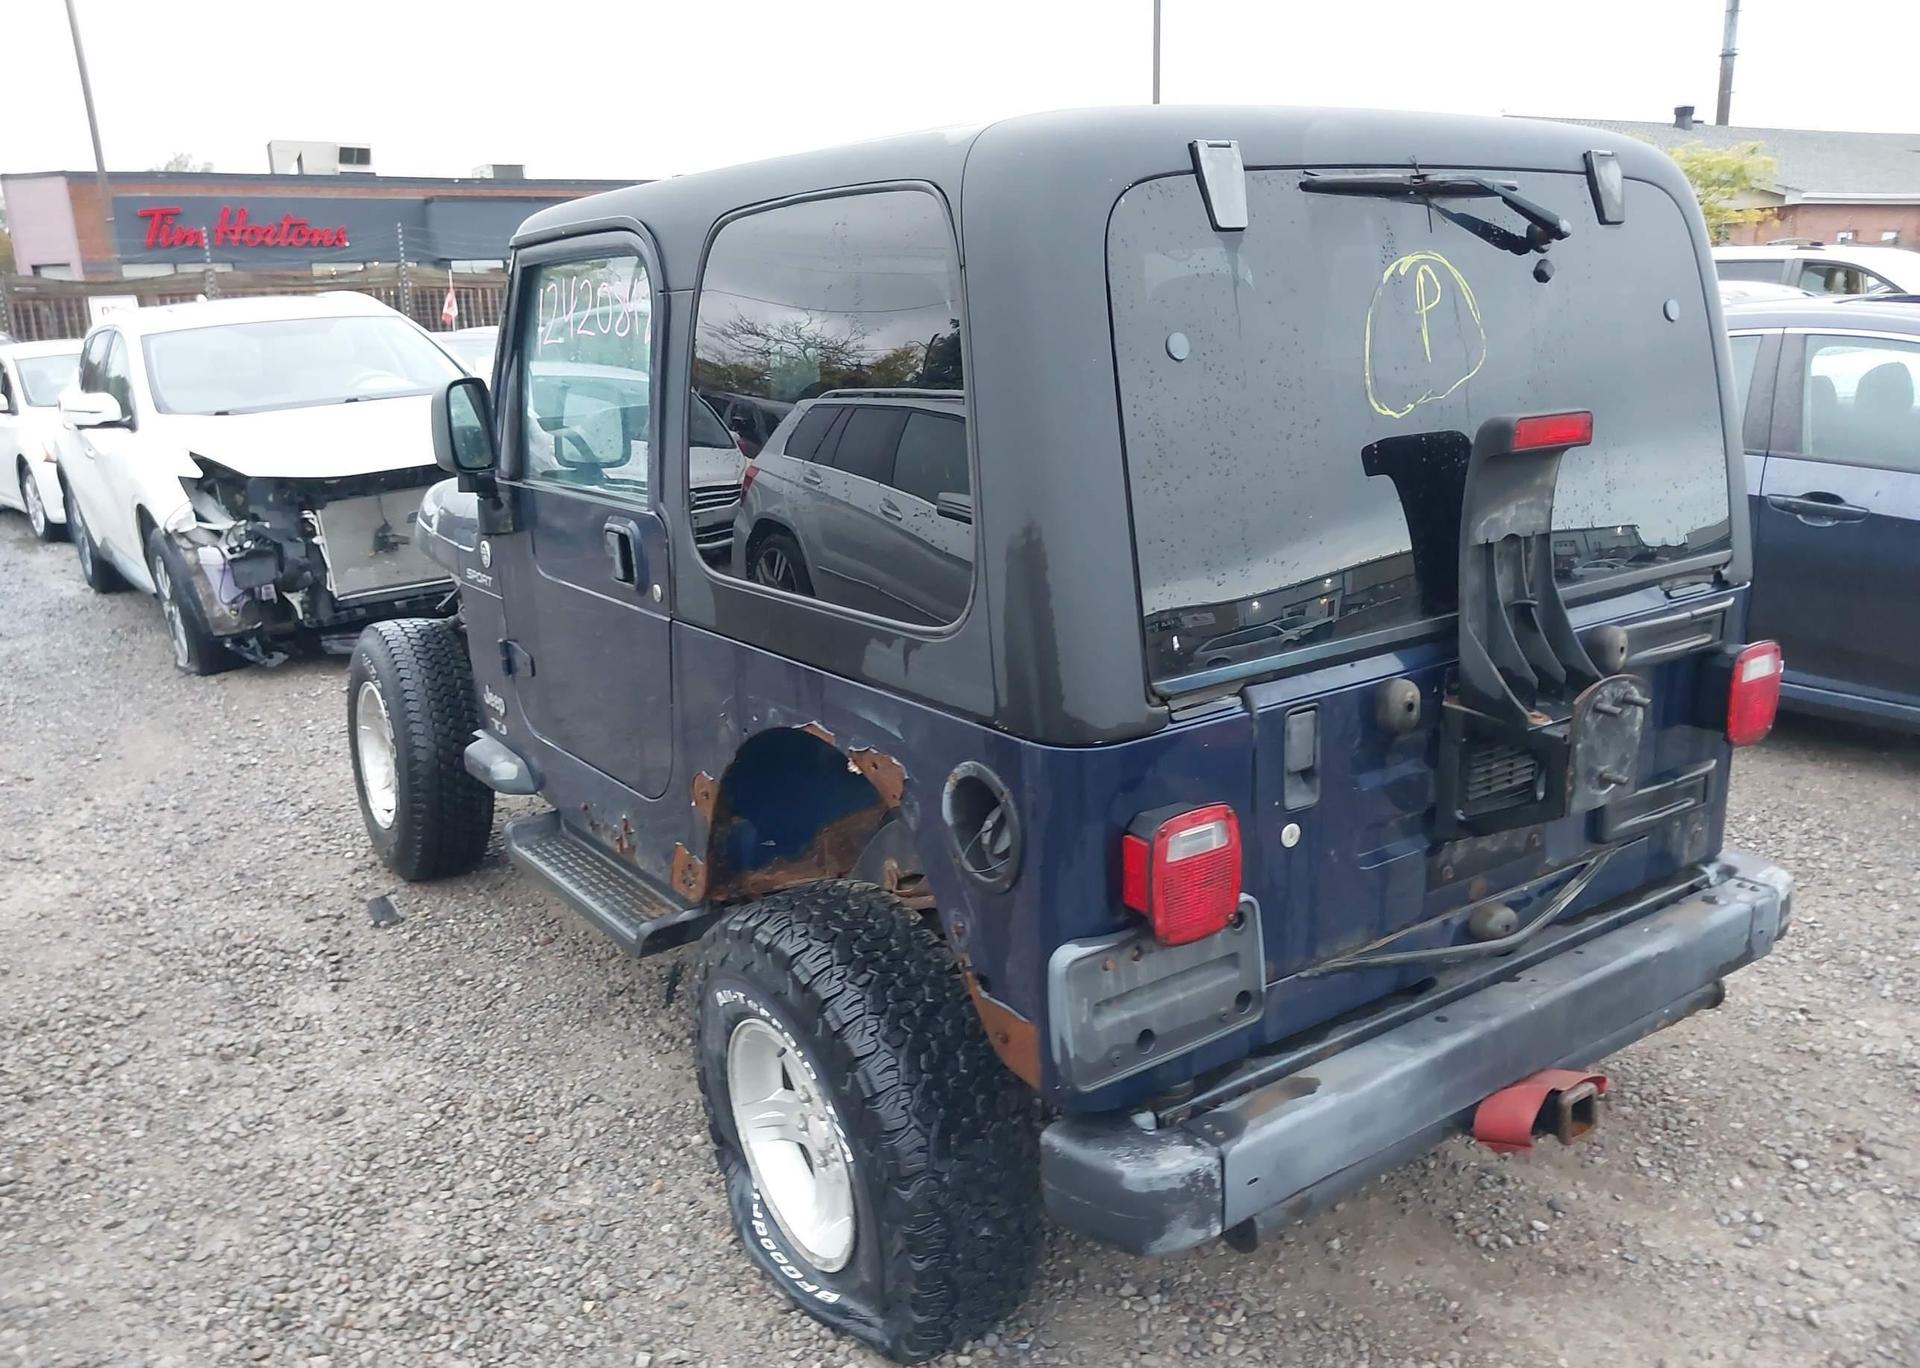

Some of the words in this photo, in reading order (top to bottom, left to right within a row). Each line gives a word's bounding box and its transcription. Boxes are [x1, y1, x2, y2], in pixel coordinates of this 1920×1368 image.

[138, 207, 206, 248] Tim
[213, 205, 348, 247] Hortons
[1416, 264, 1441, 363] P
[466, 568, 493, 587] SPORT
[484, 685, 506, 716] Jeep
